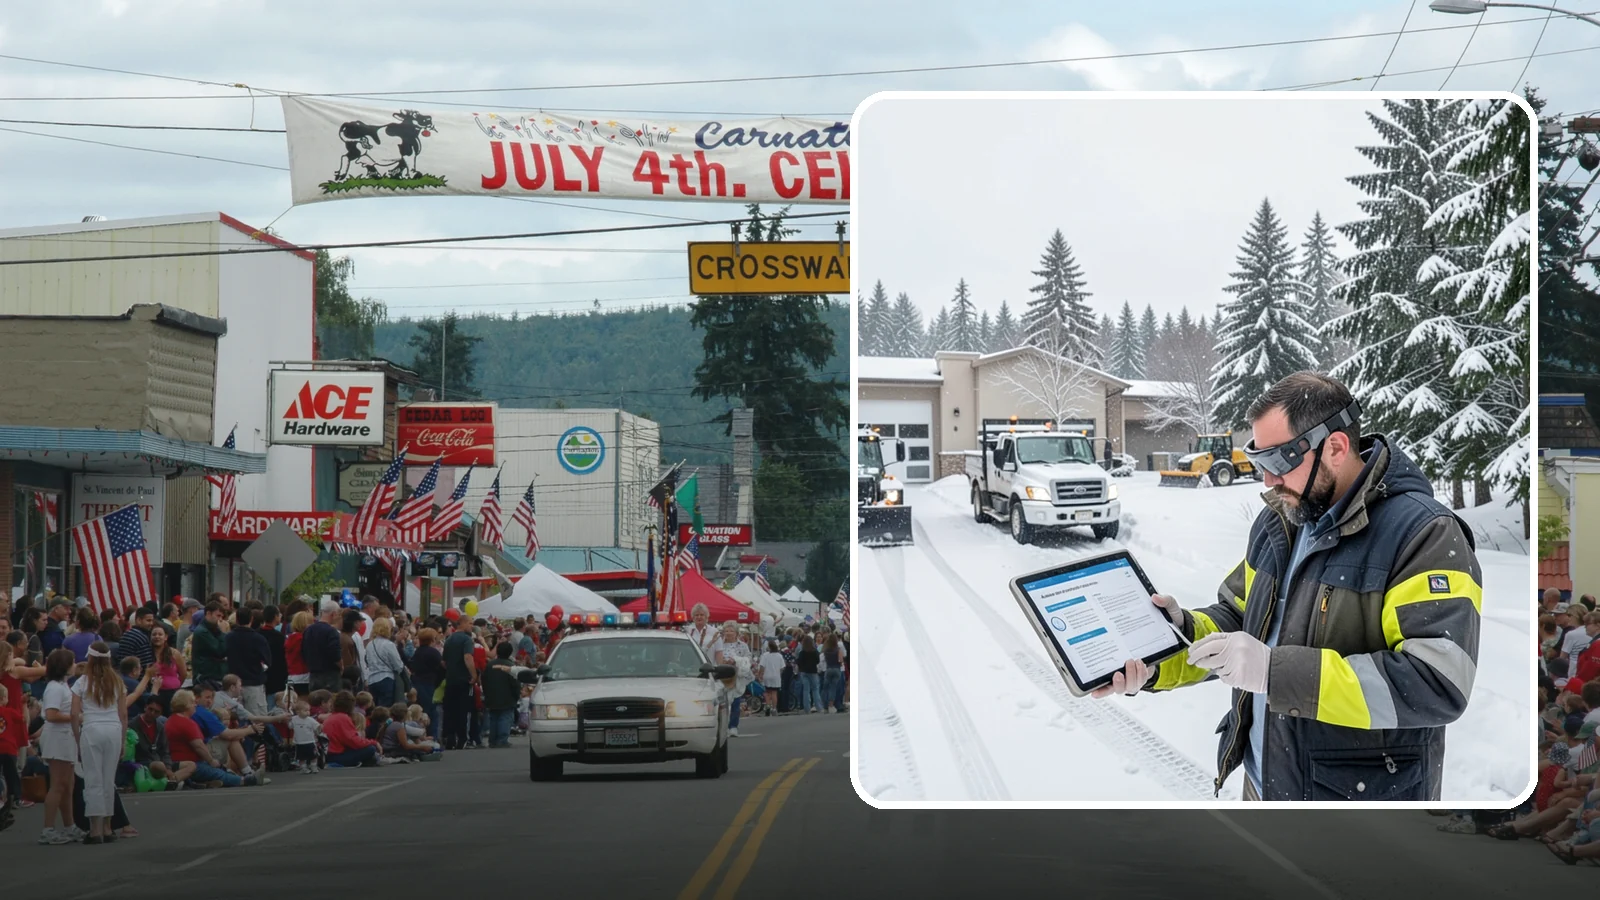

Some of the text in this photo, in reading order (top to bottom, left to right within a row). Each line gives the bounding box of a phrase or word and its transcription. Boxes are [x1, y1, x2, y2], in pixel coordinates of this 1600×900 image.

[481, 141, 604, 192] JULY
[632, 150, 747, 198] 4th.
[697, 254, 850, 280] CROSSWA
[283, 380, 373, 420] ACE
[406, 409, 452, 421] CEDAR
[283, 421, 370, 437] Hardware
[416, 428, 477, 447] Coca-Cola
[353, 467, 386, 480] Simpl
[83, 485, 155, 495] St. Vincent de Paul
[81, 503, 154, 522] THT
[688, 526, 741, 535] CRNATION
[699, 535, 730, 544] GLASS
